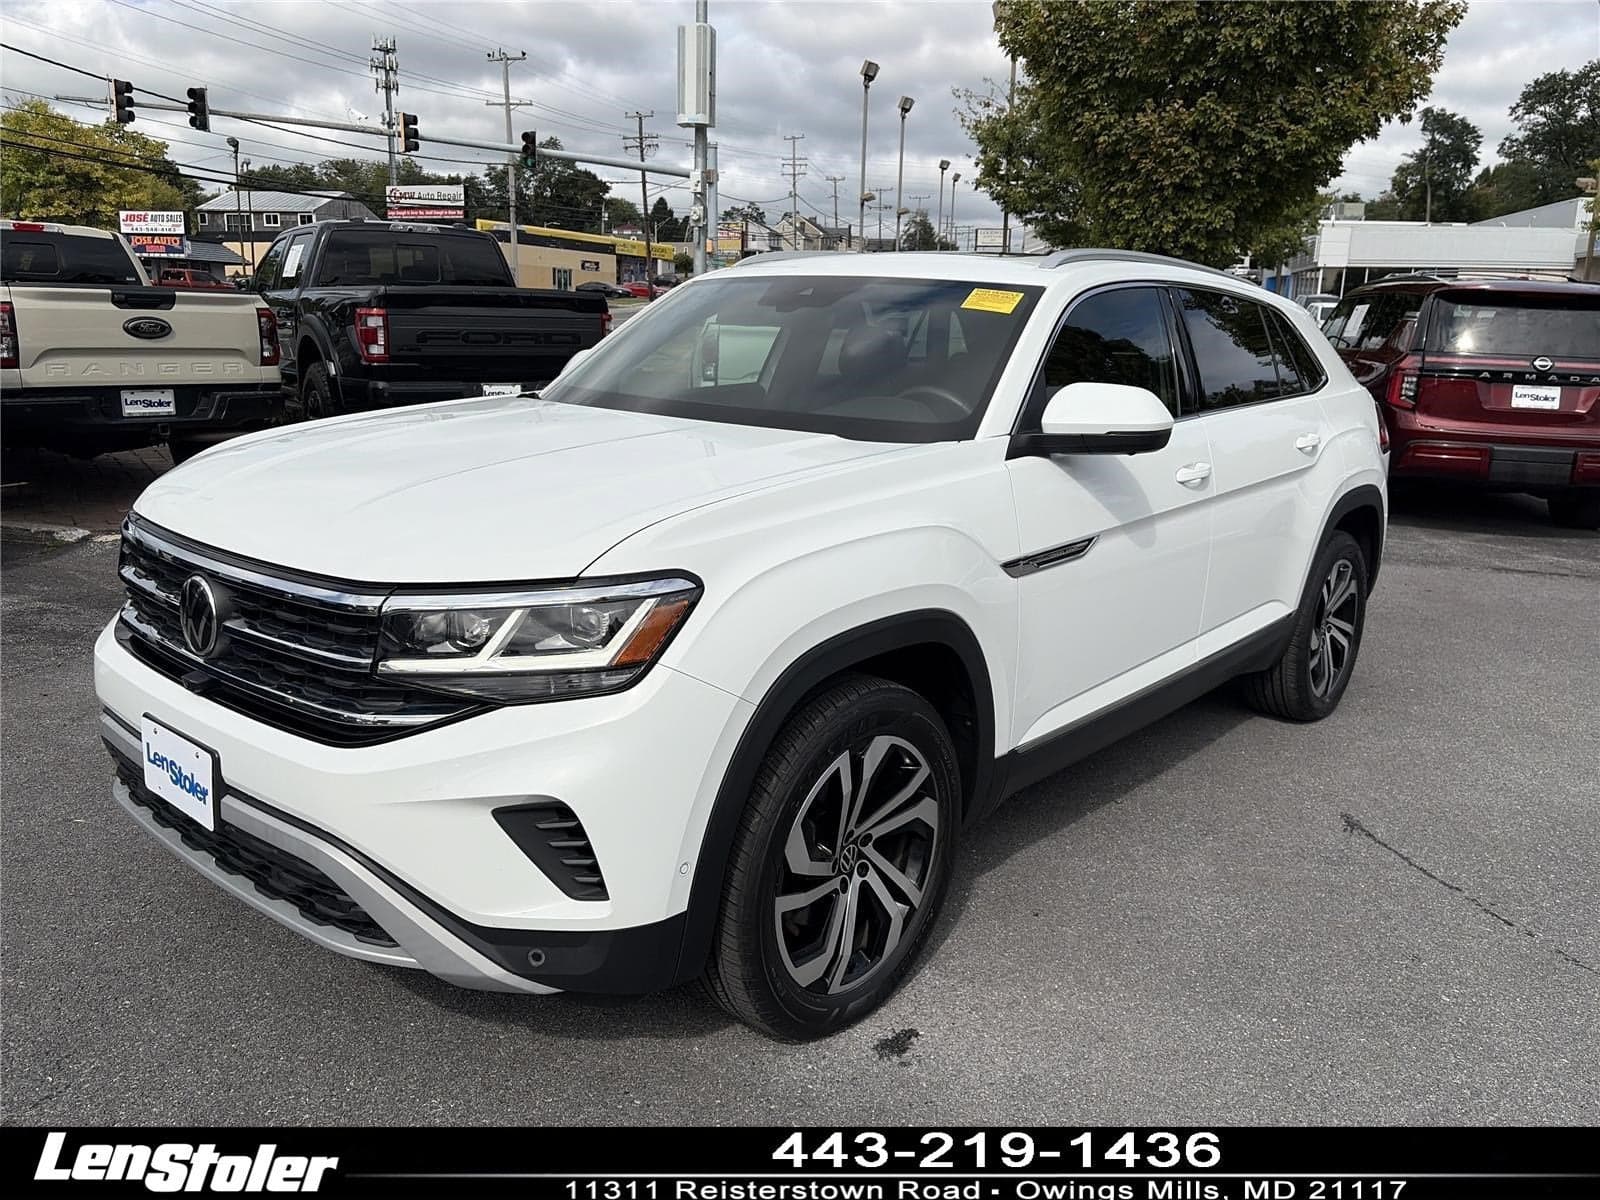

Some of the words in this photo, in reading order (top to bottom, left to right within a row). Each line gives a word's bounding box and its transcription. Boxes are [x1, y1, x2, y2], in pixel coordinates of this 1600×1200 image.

[417, 191, 435, 200] Auto
[436, 191, 463, 202] Repair
[122, 212, 149, 223] JOSÉ
[150, 213, 165, 223] AUTO
[166, 213, 183, 223] SALES
[153, 235, 180, 246] AUTO
[45, 362, 245, 377] RANGER
[1479, 371, 1600, 383] ARMADA
